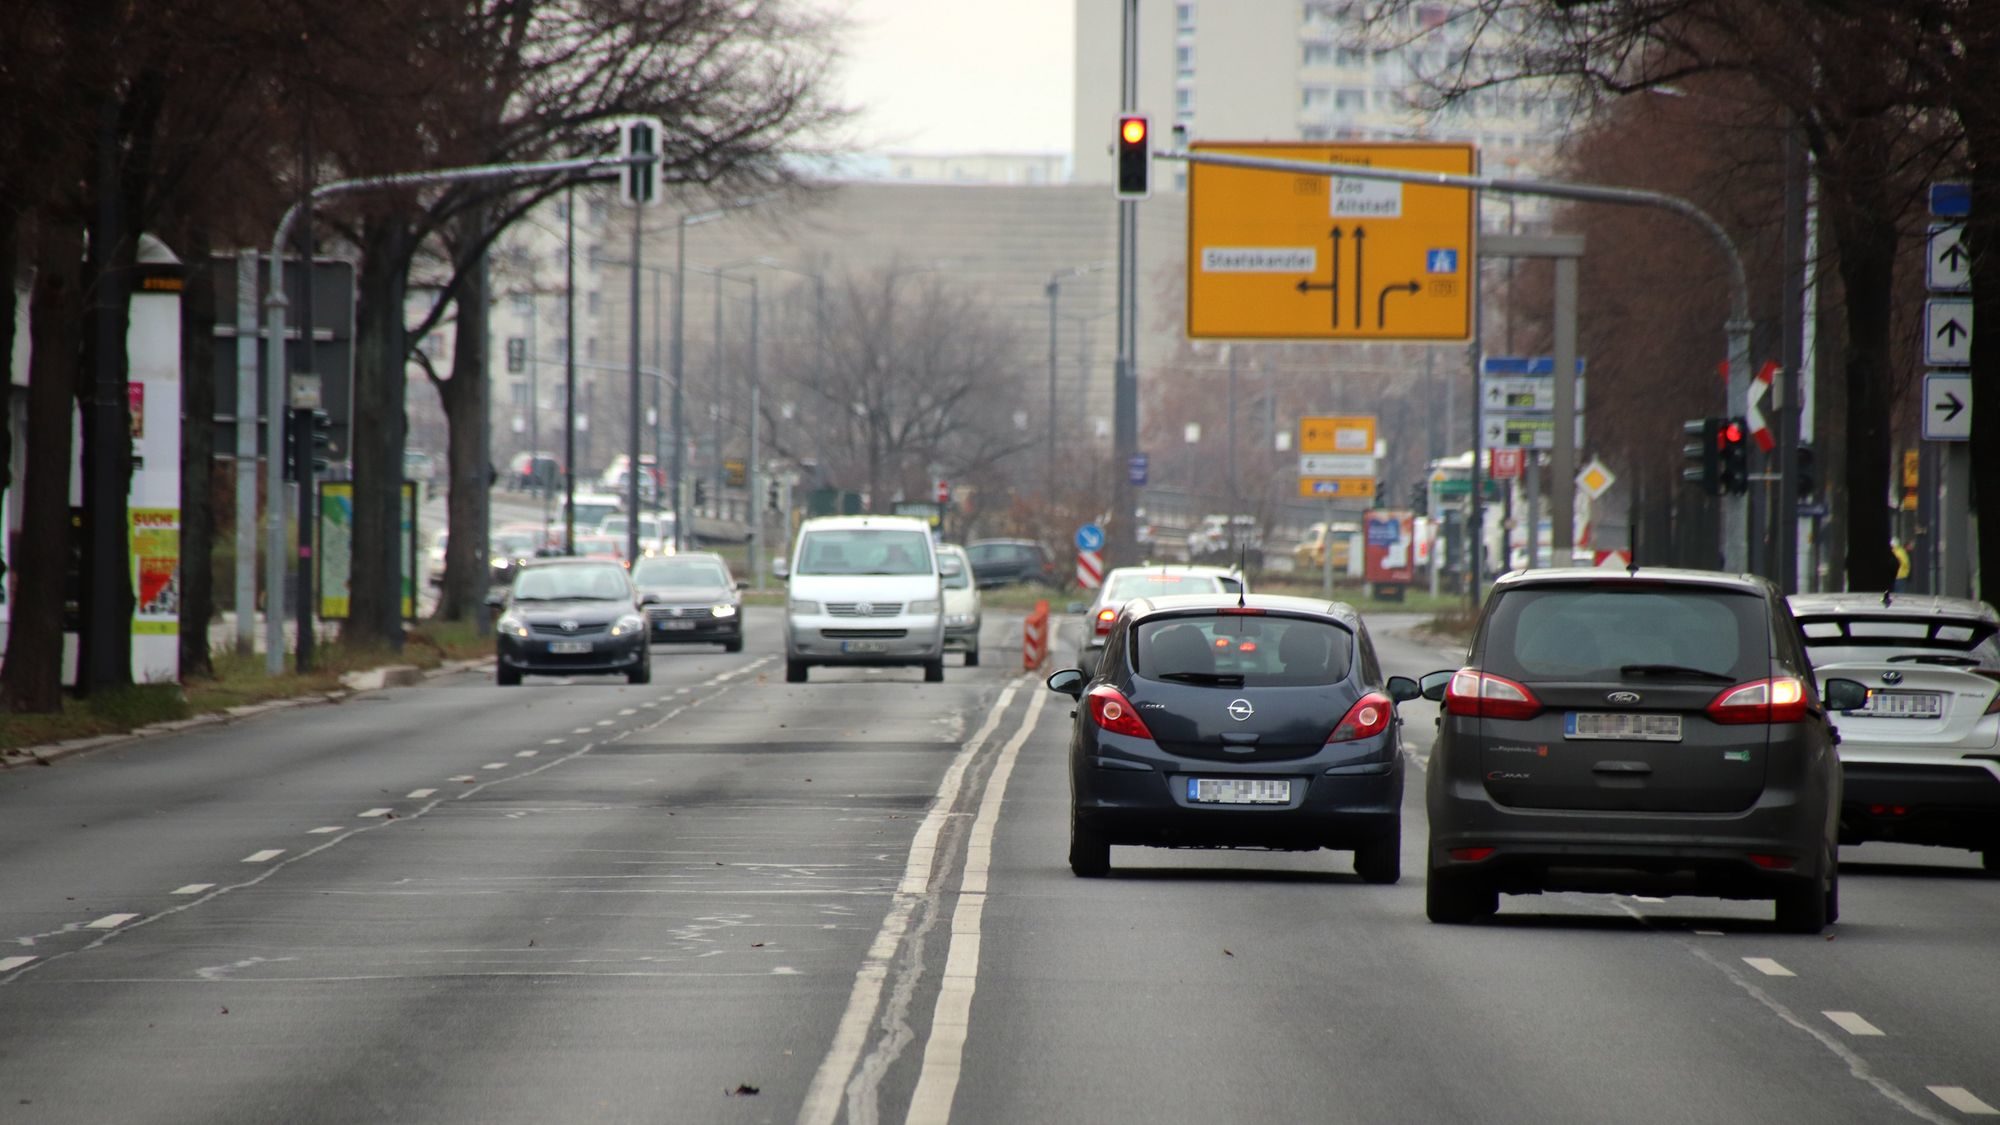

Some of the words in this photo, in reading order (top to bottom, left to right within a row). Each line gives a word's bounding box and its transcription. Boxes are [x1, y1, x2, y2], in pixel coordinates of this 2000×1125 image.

[1335, 179, 1363, 195] Zoo
[1336, 198, 1397, 213] Altstadt
[1206, 250, 1313, 267] Staatskanzlei
[133, 512, 173, 527] SUCHE
